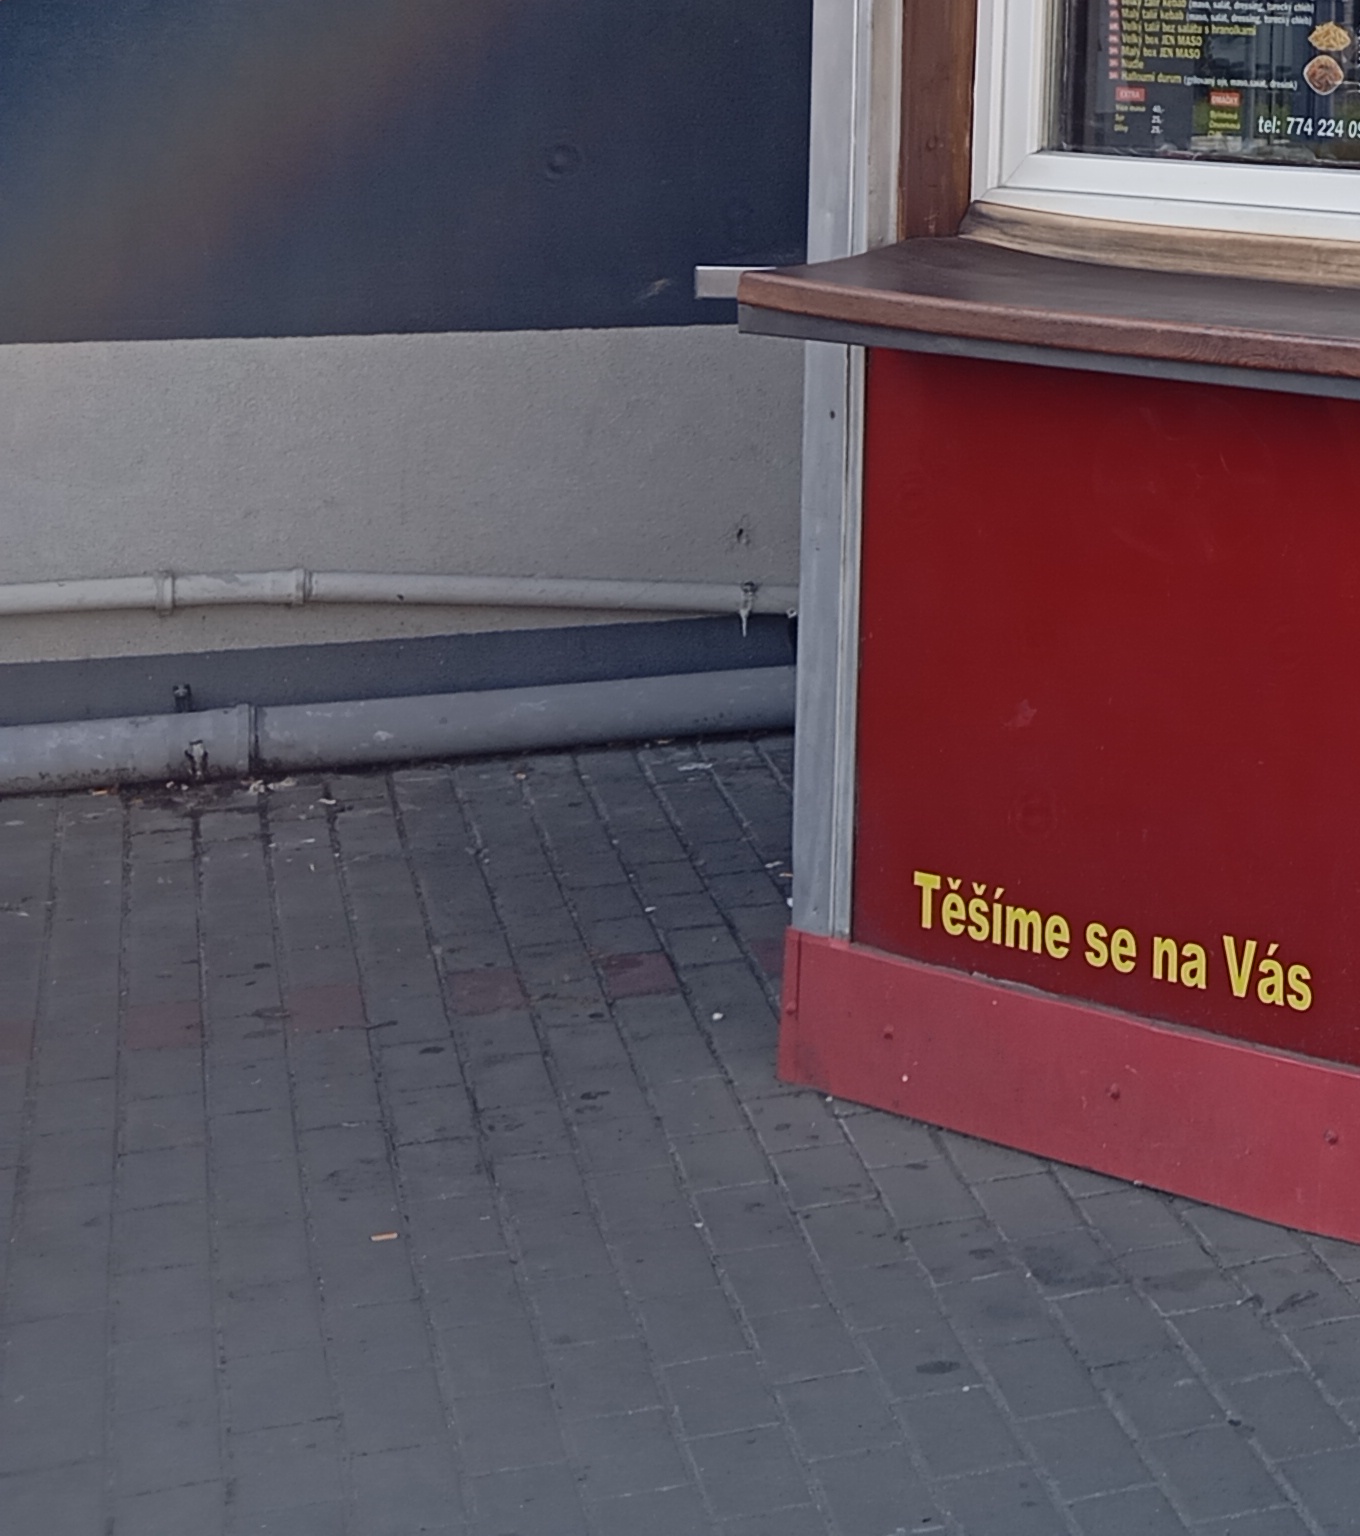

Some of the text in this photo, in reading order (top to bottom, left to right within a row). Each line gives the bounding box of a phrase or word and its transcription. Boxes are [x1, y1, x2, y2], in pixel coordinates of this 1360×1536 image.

[1176, 35, 1202, 46] MASO
[1175, 47, 1200, 59] MASO
[1258, 116, 1281, 134] tel:
[1286, 117, 1313, 136] 774
[1316, 119, 1344, 137] 224
[912, 870, 1313, 1012] Těšíme se na Vás
